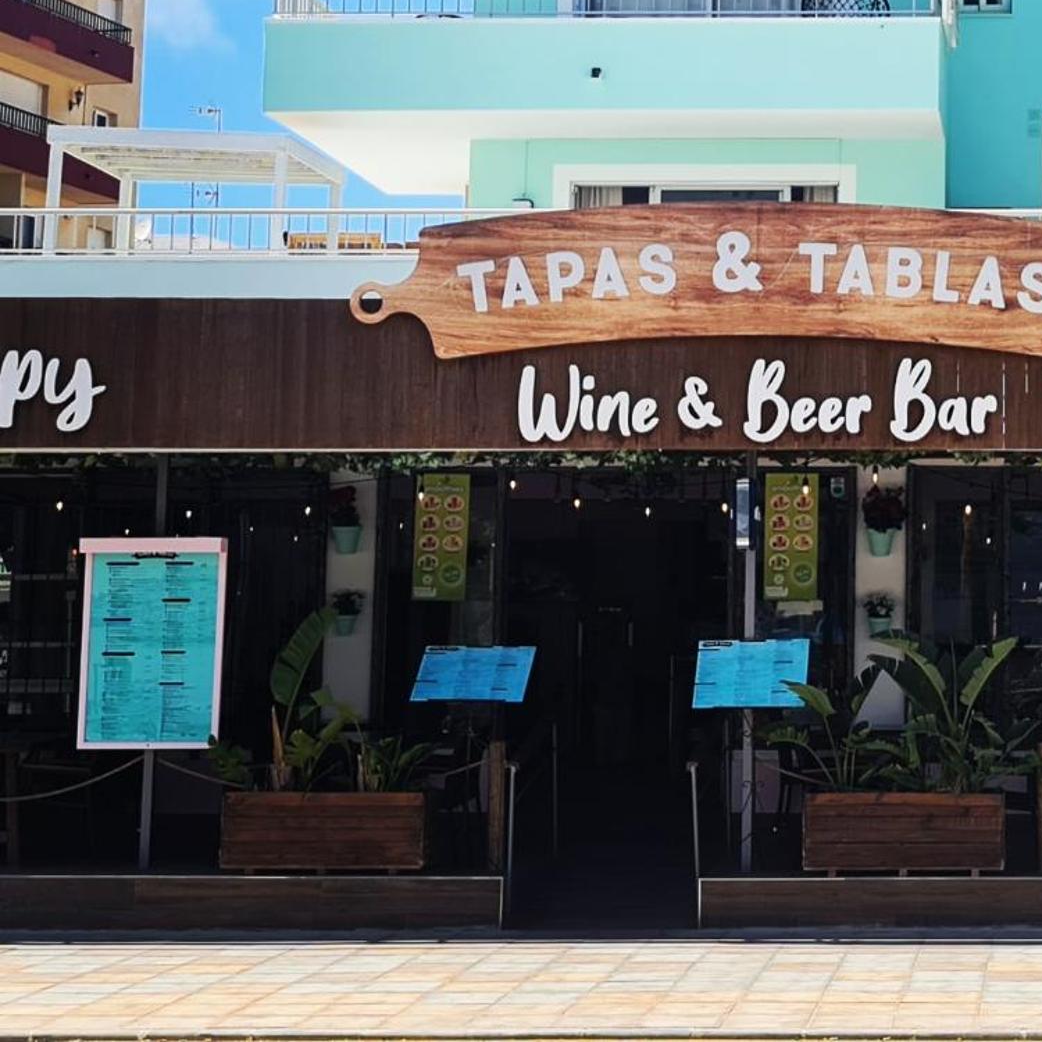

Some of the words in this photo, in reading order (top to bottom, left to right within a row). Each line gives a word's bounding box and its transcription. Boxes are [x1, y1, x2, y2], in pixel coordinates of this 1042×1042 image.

[457, 244, 676, 312] TAPAS
[713, 232, 762, 292] &
[518, 365, 659, 441] Wine
[678, 377, 722, 429] &
[744, 359, 871, 442] Beer
[890, 358, 997, 441] Bar
